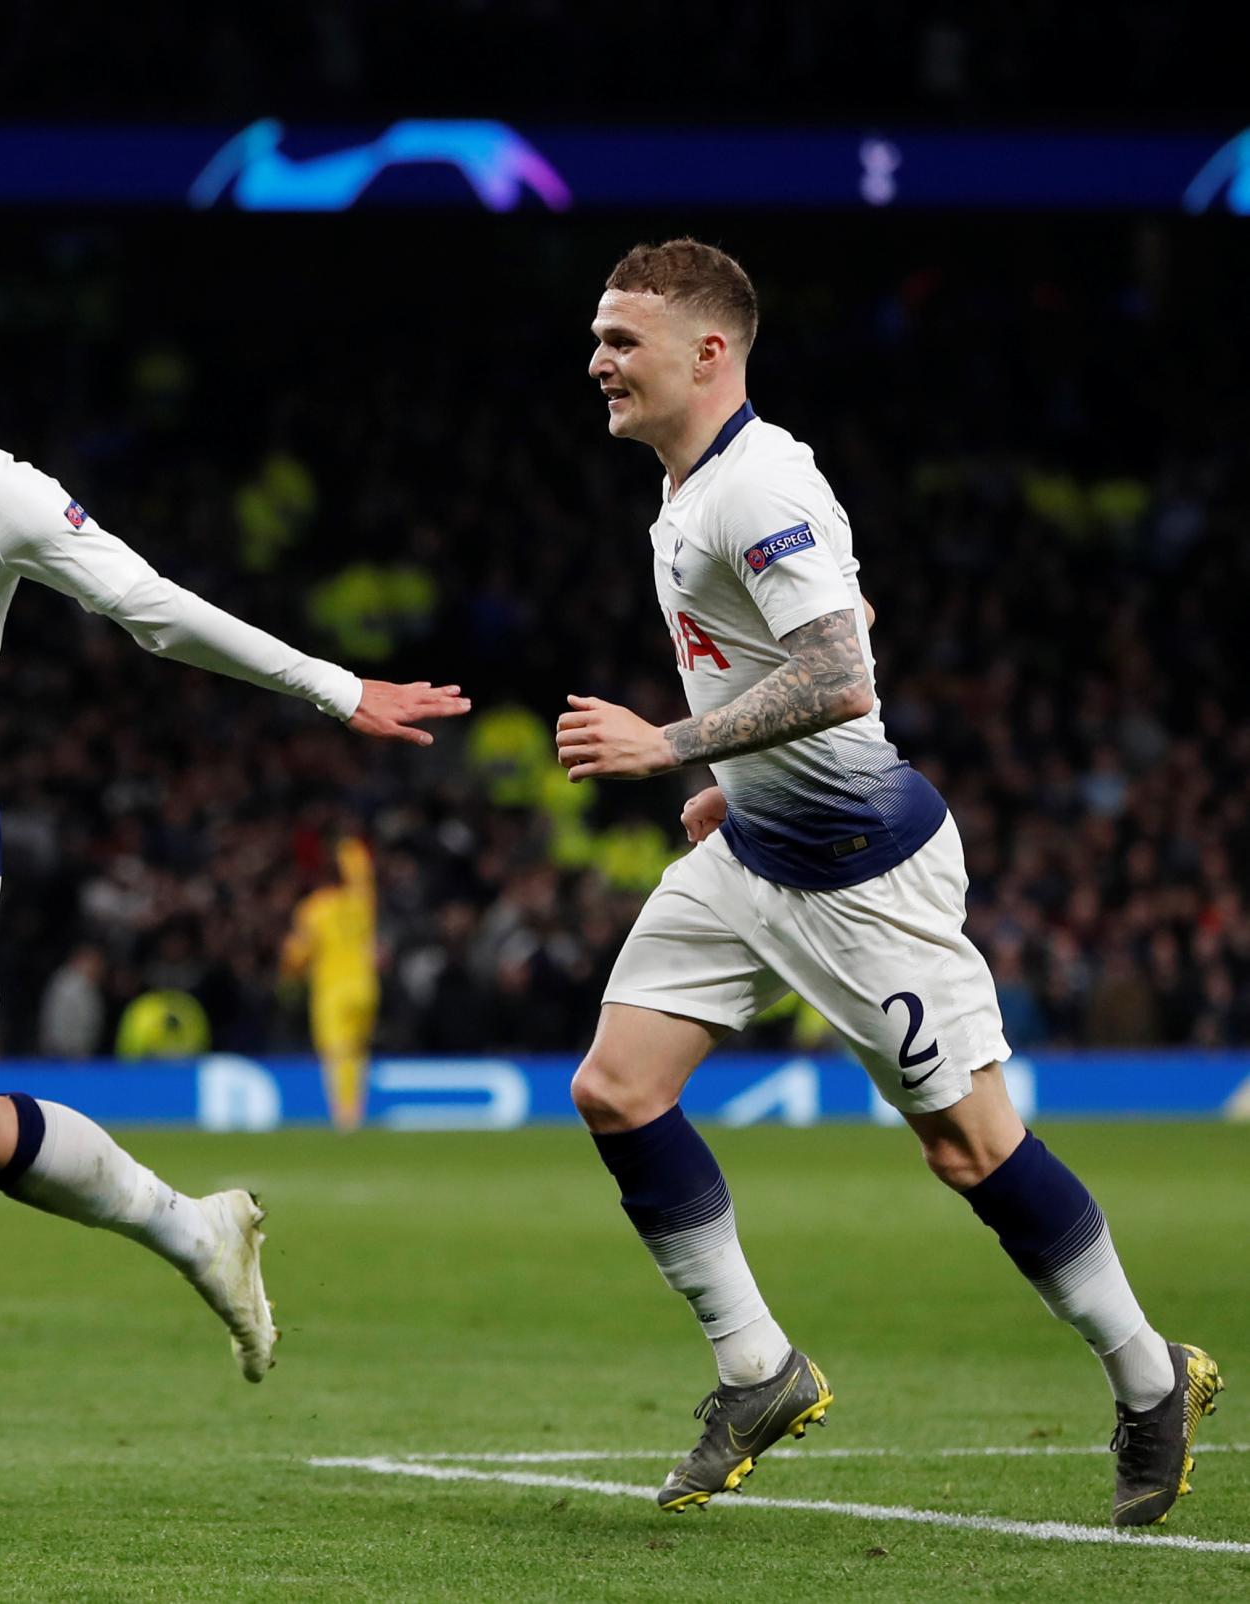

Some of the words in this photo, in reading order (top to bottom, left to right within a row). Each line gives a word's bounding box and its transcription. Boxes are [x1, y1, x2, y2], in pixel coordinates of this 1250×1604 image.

[762, 529, 813, 558] RESPECT
[668, 609, 732, 672] IA
[880, 991, 939, 1070] 2
